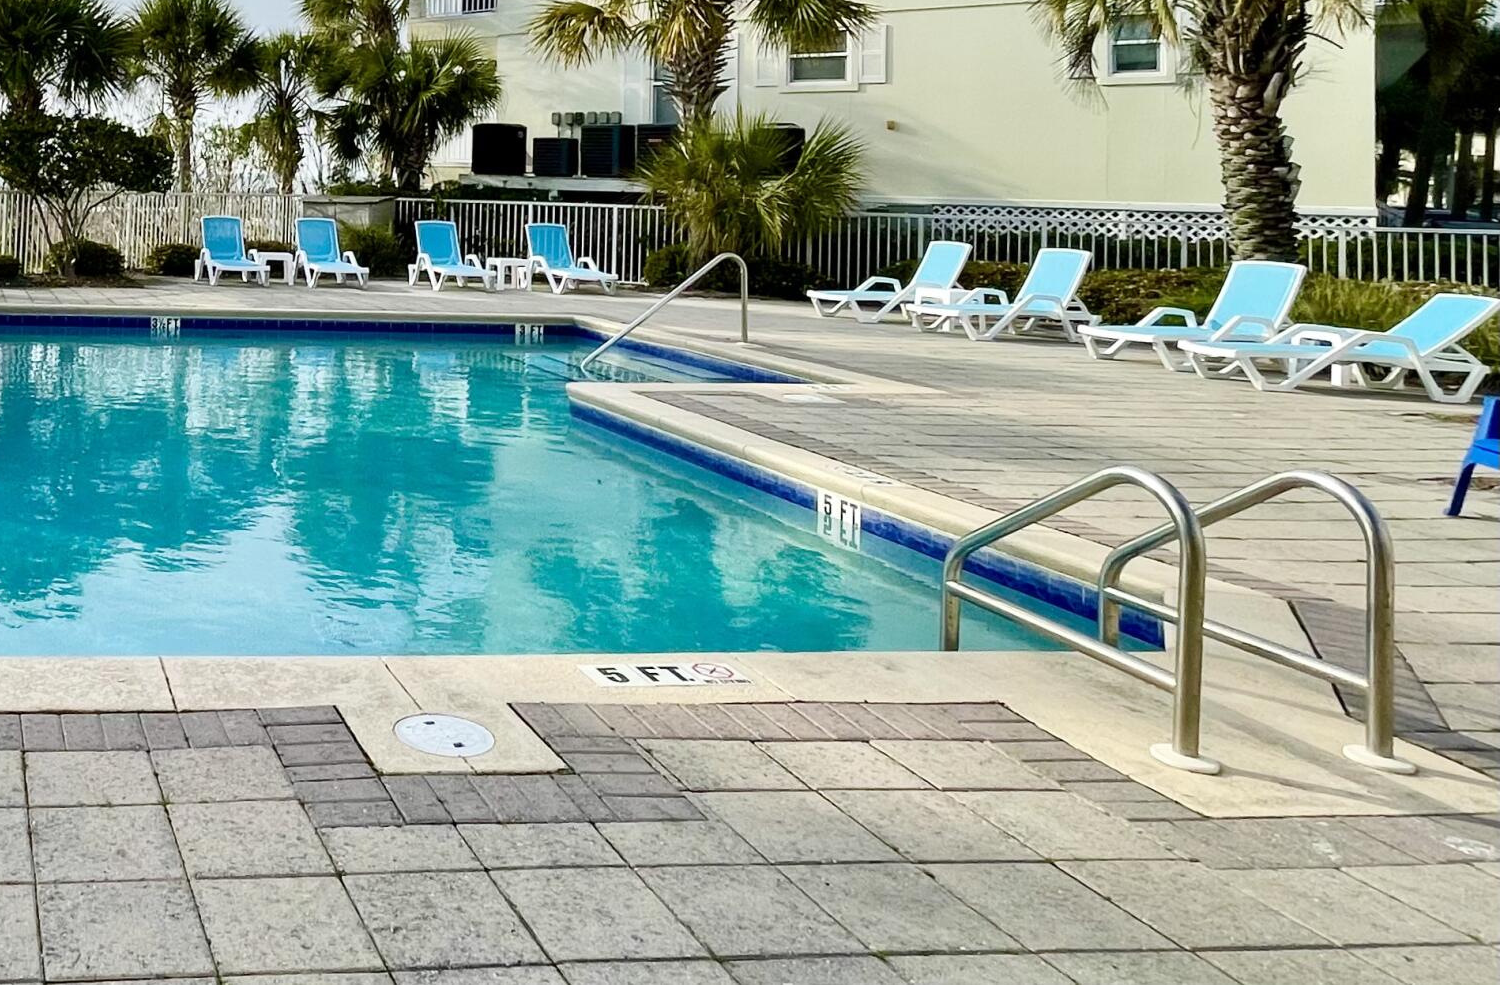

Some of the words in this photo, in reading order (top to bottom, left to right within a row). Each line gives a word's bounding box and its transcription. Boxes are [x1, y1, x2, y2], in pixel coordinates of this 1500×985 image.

[824, 494, 832, 516] 5
[597, 667, 630, 683] 5
[636, 666, 695, 682] FT.
